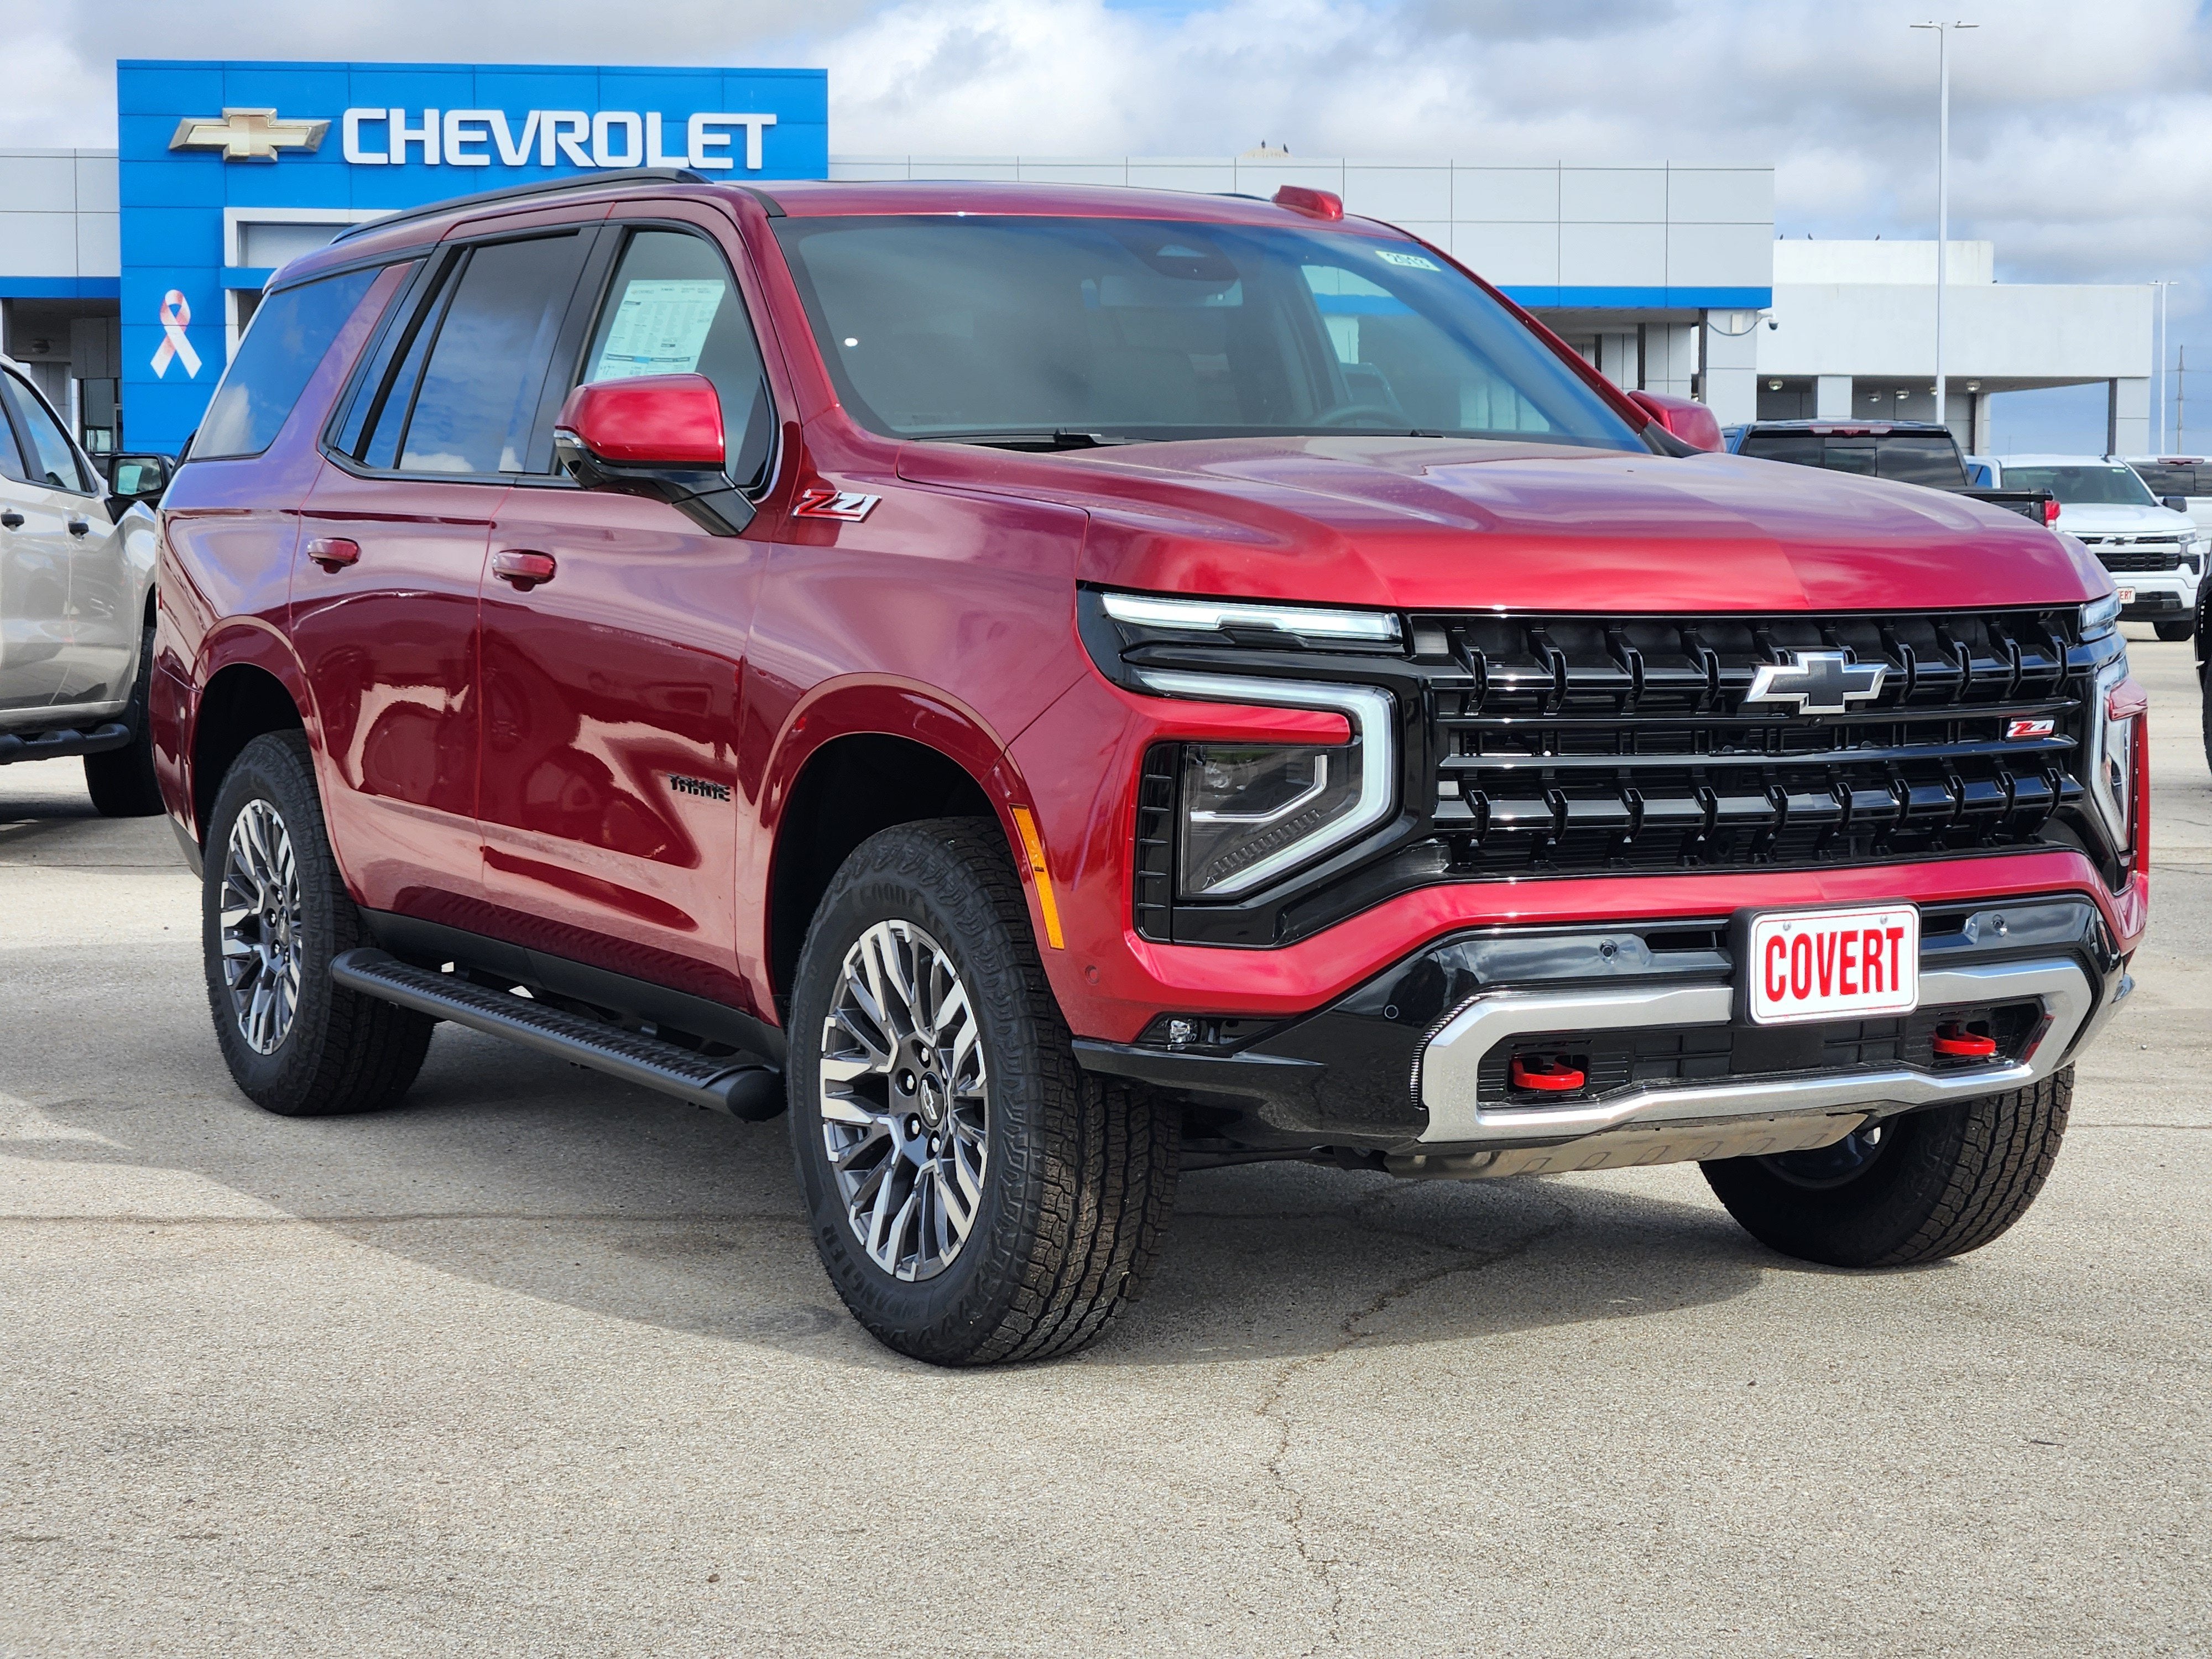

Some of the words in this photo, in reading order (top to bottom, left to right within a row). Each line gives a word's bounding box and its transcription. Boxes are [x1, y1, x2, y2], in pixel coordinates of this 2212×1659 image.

[343, 107, 777, 169] CHEVROLET
[2118, 590, 2133, 600] ERT
[1765, 926, 1905, 1002] COVERT
